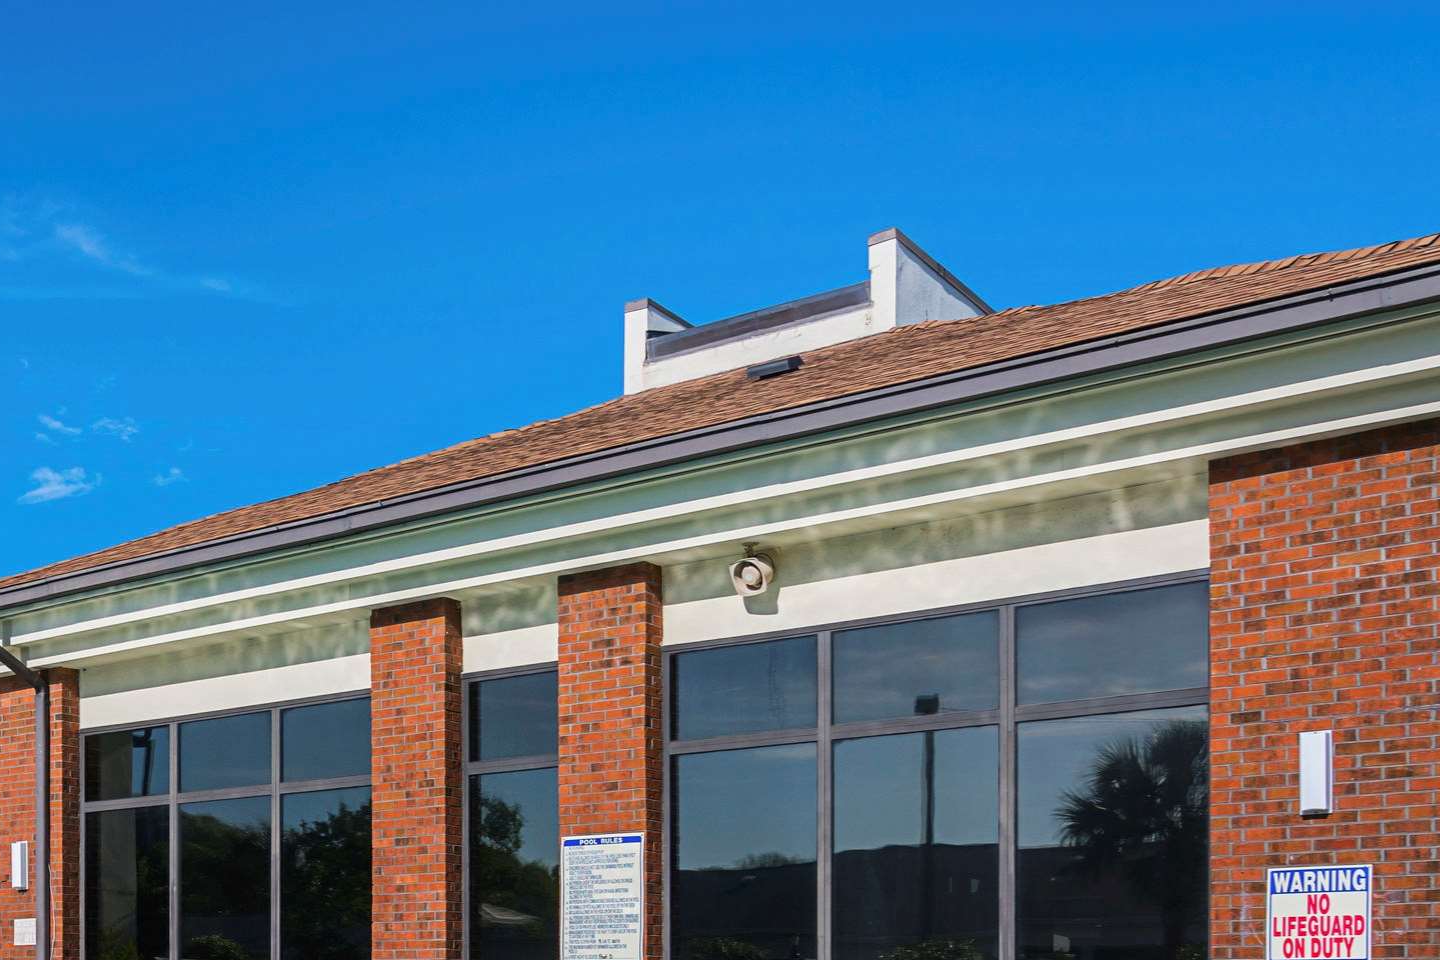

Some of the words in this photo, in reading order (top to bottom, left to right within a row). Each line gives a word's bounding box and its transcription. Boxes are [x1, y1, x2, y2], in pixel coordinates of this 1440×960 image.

[1273, 869, 1367, 893] WARNING
[1307, 894, 1330, 914] NO
[1272, 915, 1365, 937] LIFEGUARD
[1282, 938, 1305, 958] ON
[1311, 937, 1354, 958] DUTY
